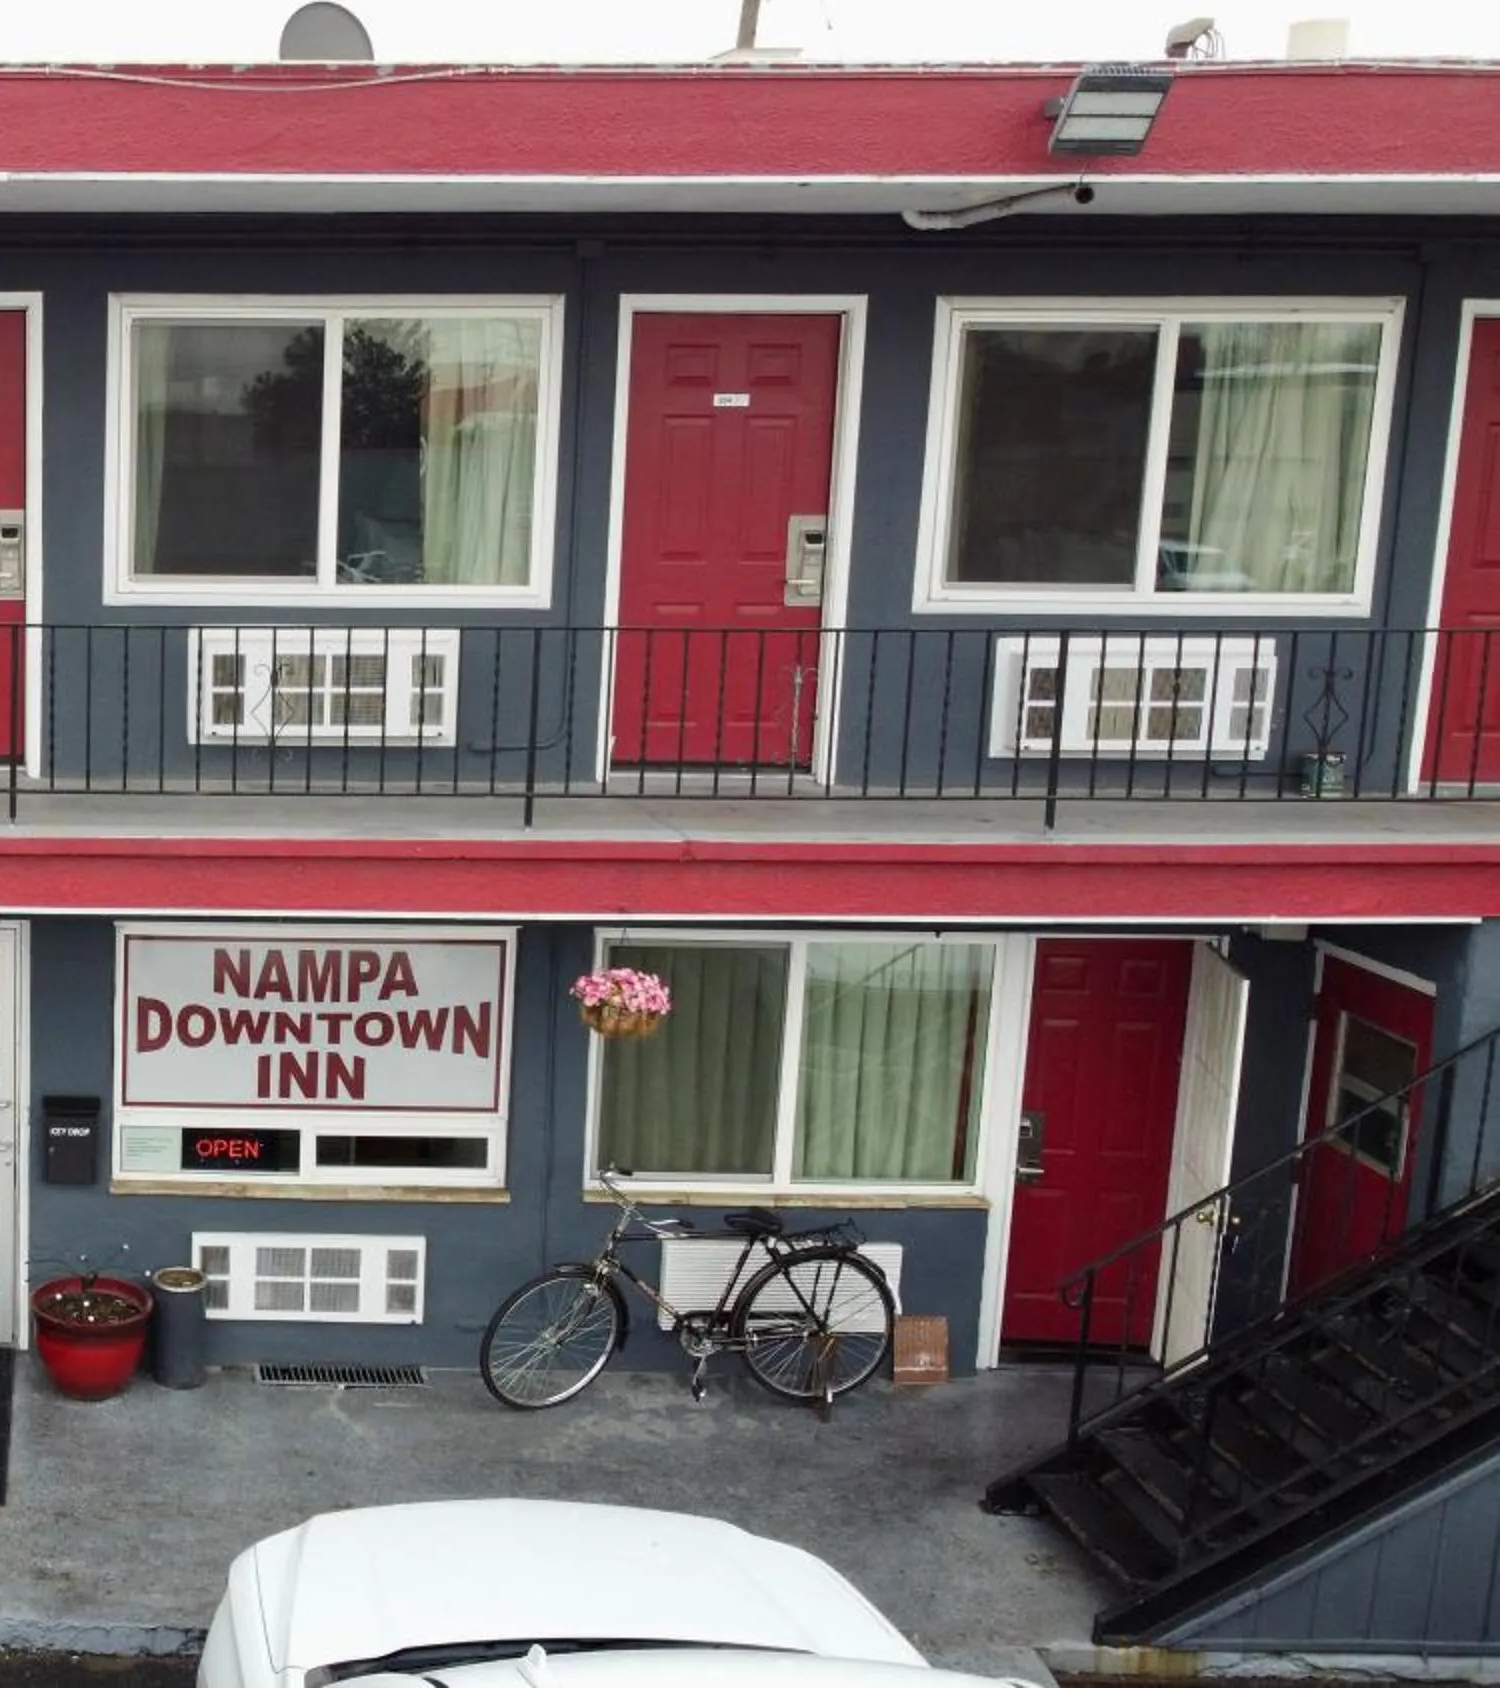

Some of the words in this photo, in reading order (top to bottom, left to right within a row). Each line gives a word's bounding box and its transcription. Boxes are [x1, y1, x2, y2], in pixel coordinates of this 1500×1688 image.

[213, 948, 419, 1002] NAMPA
[136, 996, 492, 1059] DOWNTOWN
[257, 1051, 366, 1101] INN
[195, 1138, 261, 1158] OPEN
